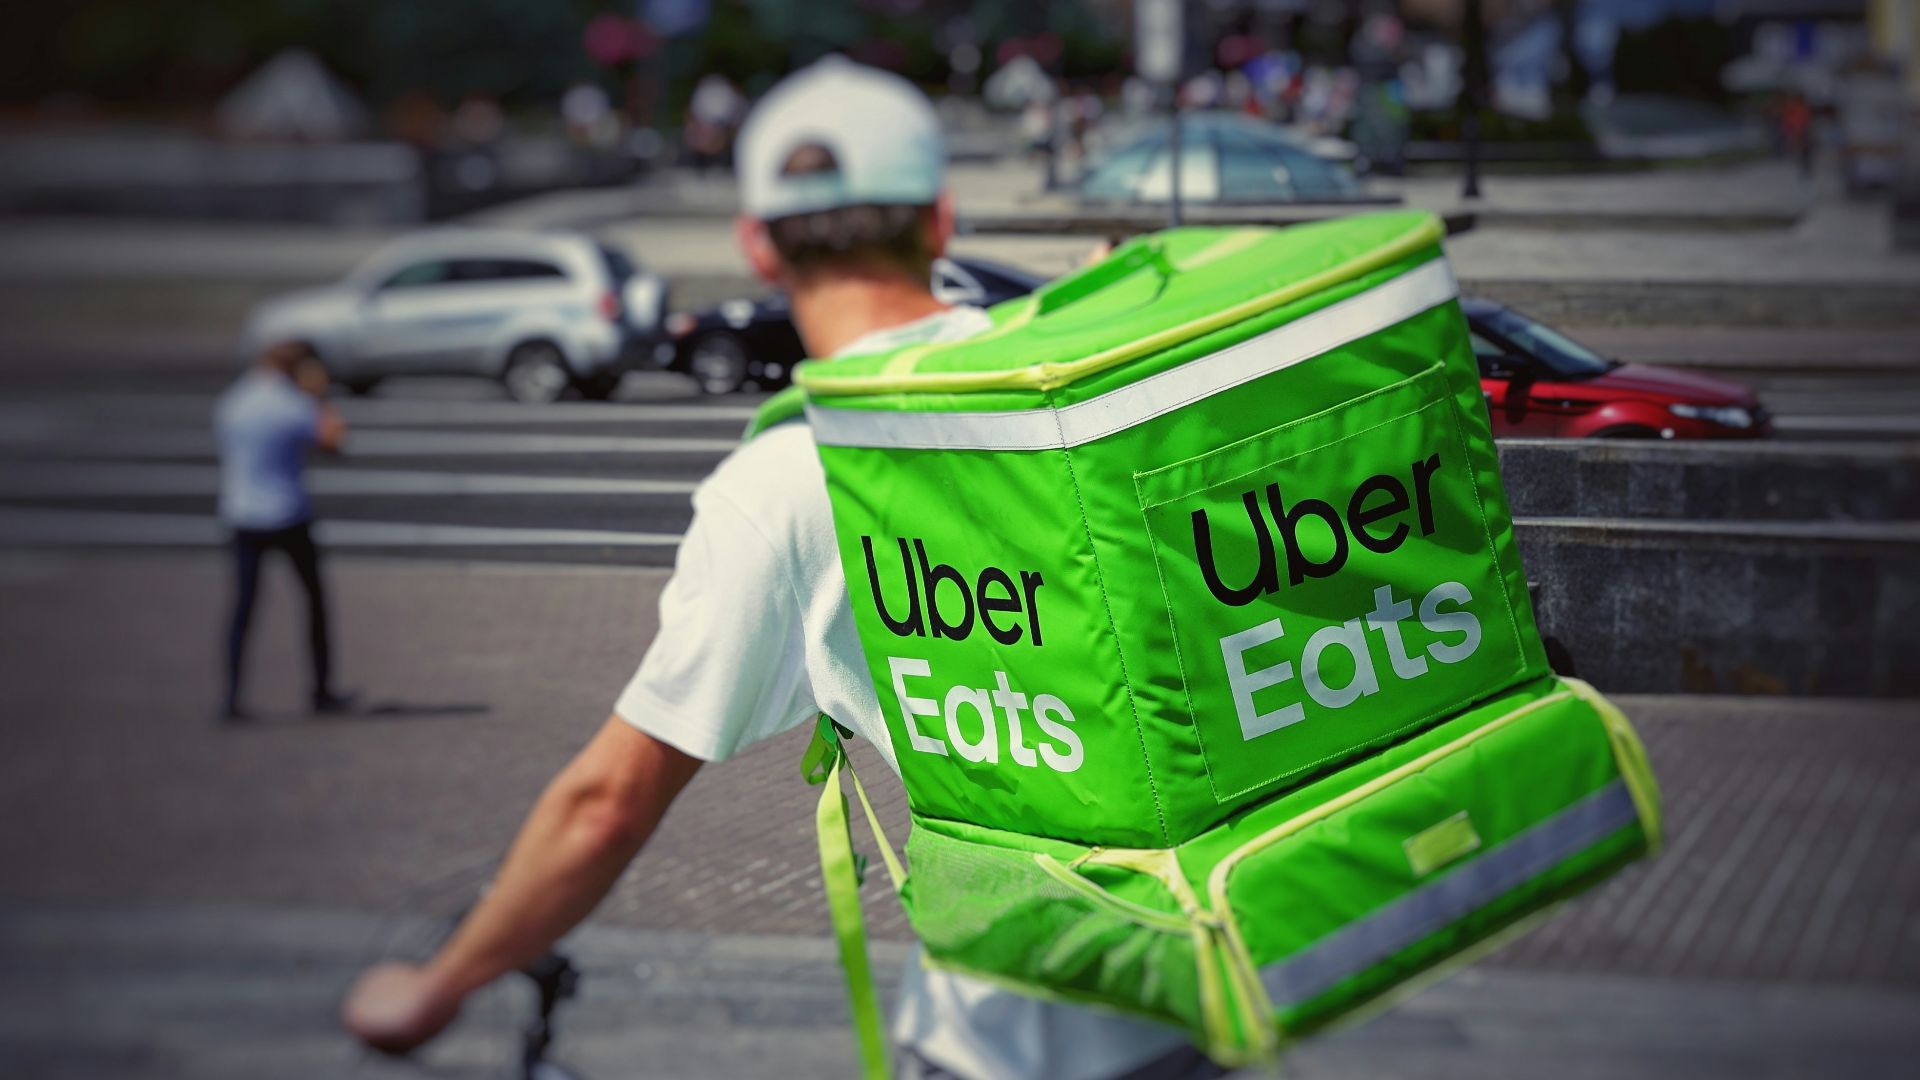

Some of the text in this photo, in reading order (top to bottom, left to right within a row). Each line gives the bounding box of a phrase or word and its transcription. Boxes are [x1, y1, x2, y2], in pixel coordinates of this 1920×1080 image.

[860, 534, 1044, 646] Uber
[1191, 453, 1441, 607] Uber
[887, 656, 1084, 773] Eats
[1219, 581, 1482, 743] Eats
